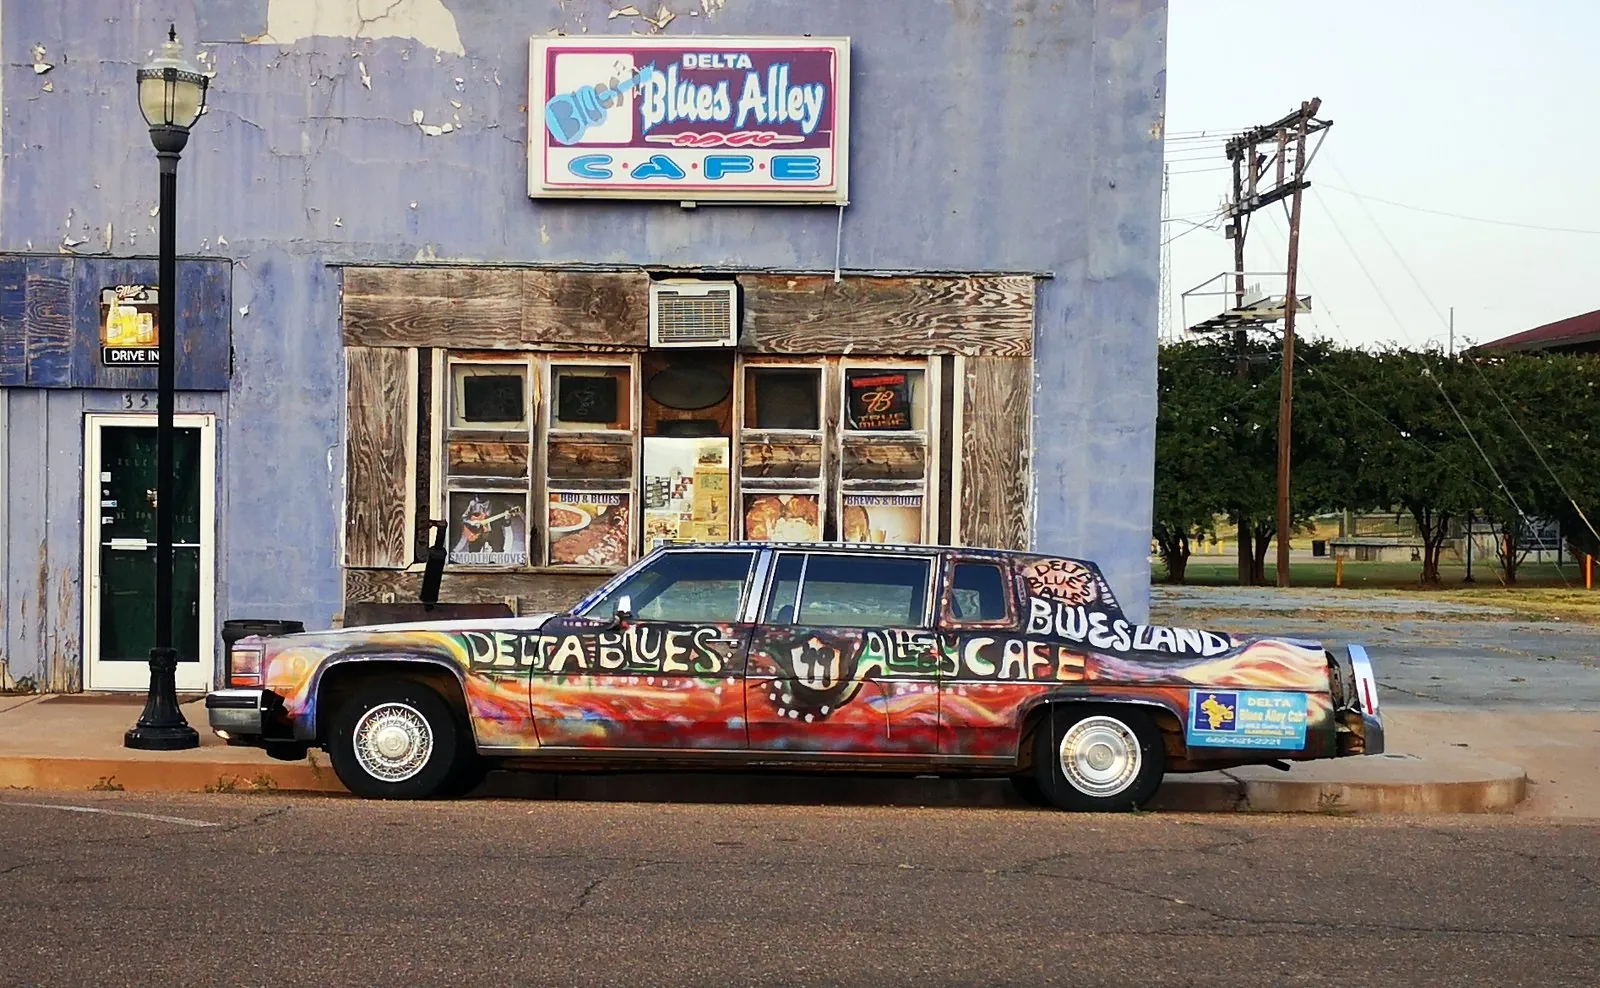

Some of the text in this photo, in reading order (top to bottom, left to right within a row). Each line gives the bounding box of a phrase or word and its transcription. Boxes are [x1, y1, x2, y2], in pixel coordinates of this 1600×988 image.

[683, 53, 752, 69] DELTA
[641, 63, 824, 134] Blues Alley
[111, 350, 145, 361] DRIVE
[125, 395, 158, 408] 35
[560, 493, 620, 505] BBQ & BLUES
[844, 495, 880, 506] BREWS
[881, 496, 890, 506] &
[450, 551, 490, 565] SMOOTH
[1035, 561, 1092, 582] DELTA
[1028, 577, 1091, 598] BLUES
[463, 626, 723, 674] DELTA BLUES
[853, 630, 1085, 684] ALLEY CAFE
[1247, 696, 1292, 708] DELTA
